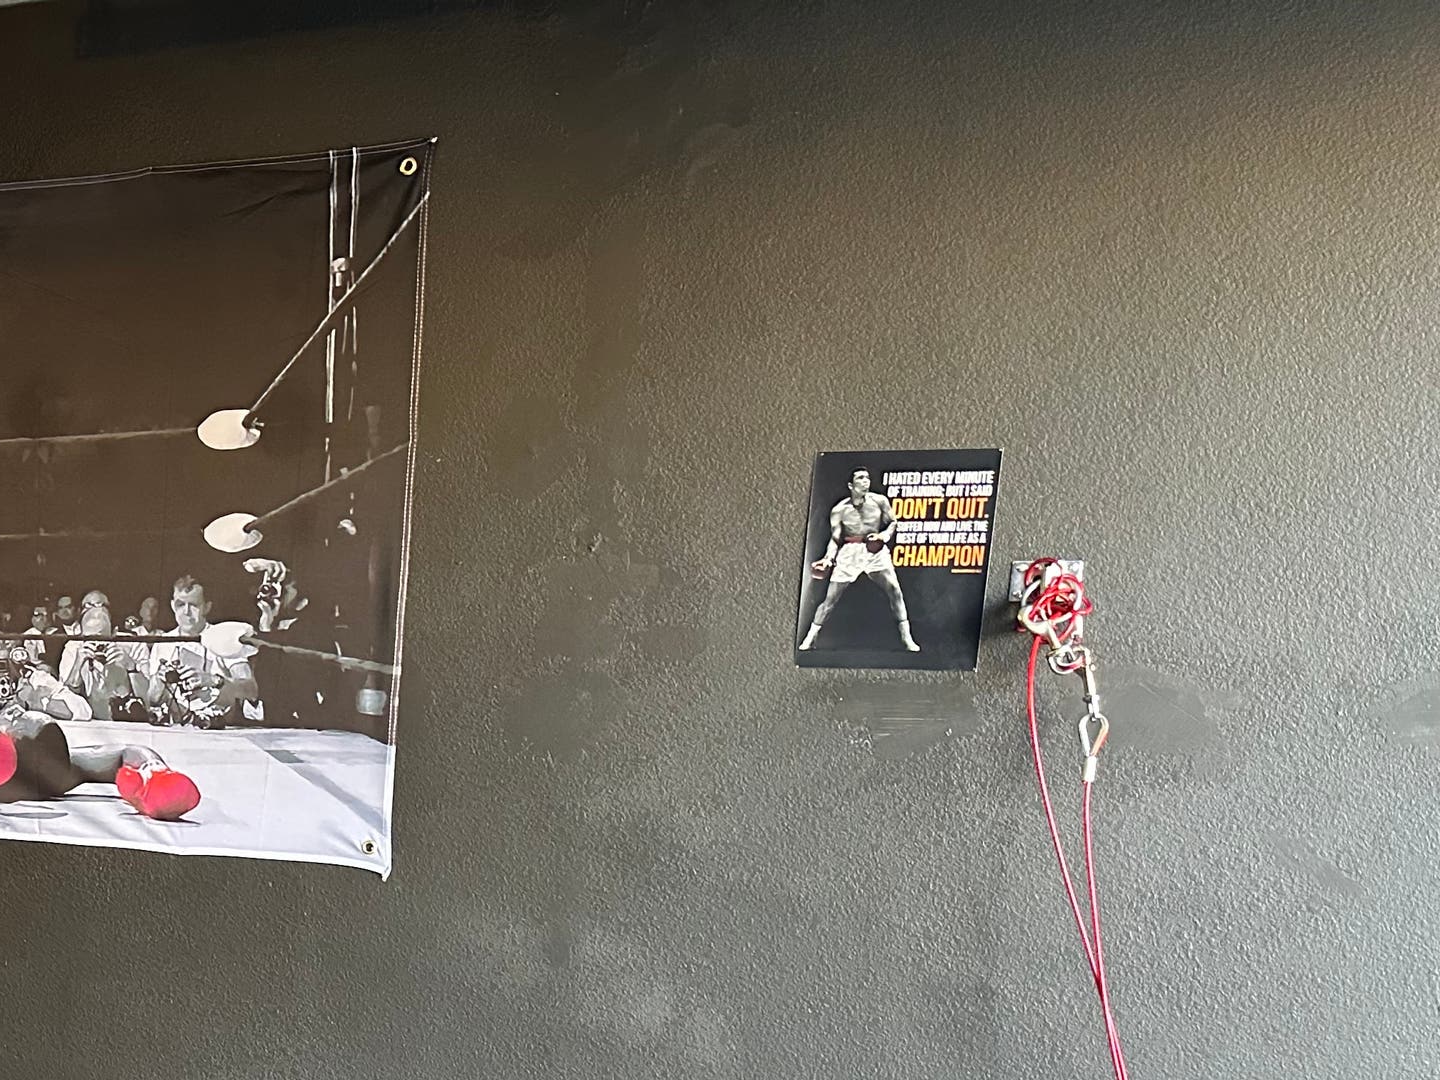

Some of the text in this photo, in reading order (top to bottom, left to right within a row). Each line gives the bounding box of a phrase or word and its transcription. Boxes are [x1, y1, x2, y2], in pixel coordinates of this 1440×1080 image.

[883, 470, 995, 485] I HATED EVERY MINUTE
[887, 486, 900, 497] OF
[945, 485, 964, 497] BUT
[970, 485, 993, 497] SAID
[946, 497, 989, 519] QUIT.
[950, 533, 967, 544] LIFE
[967, 533, 978, 544] AS
[979, 532, 987, 543] A
[892, 545, 985, 567] CHAMPION
